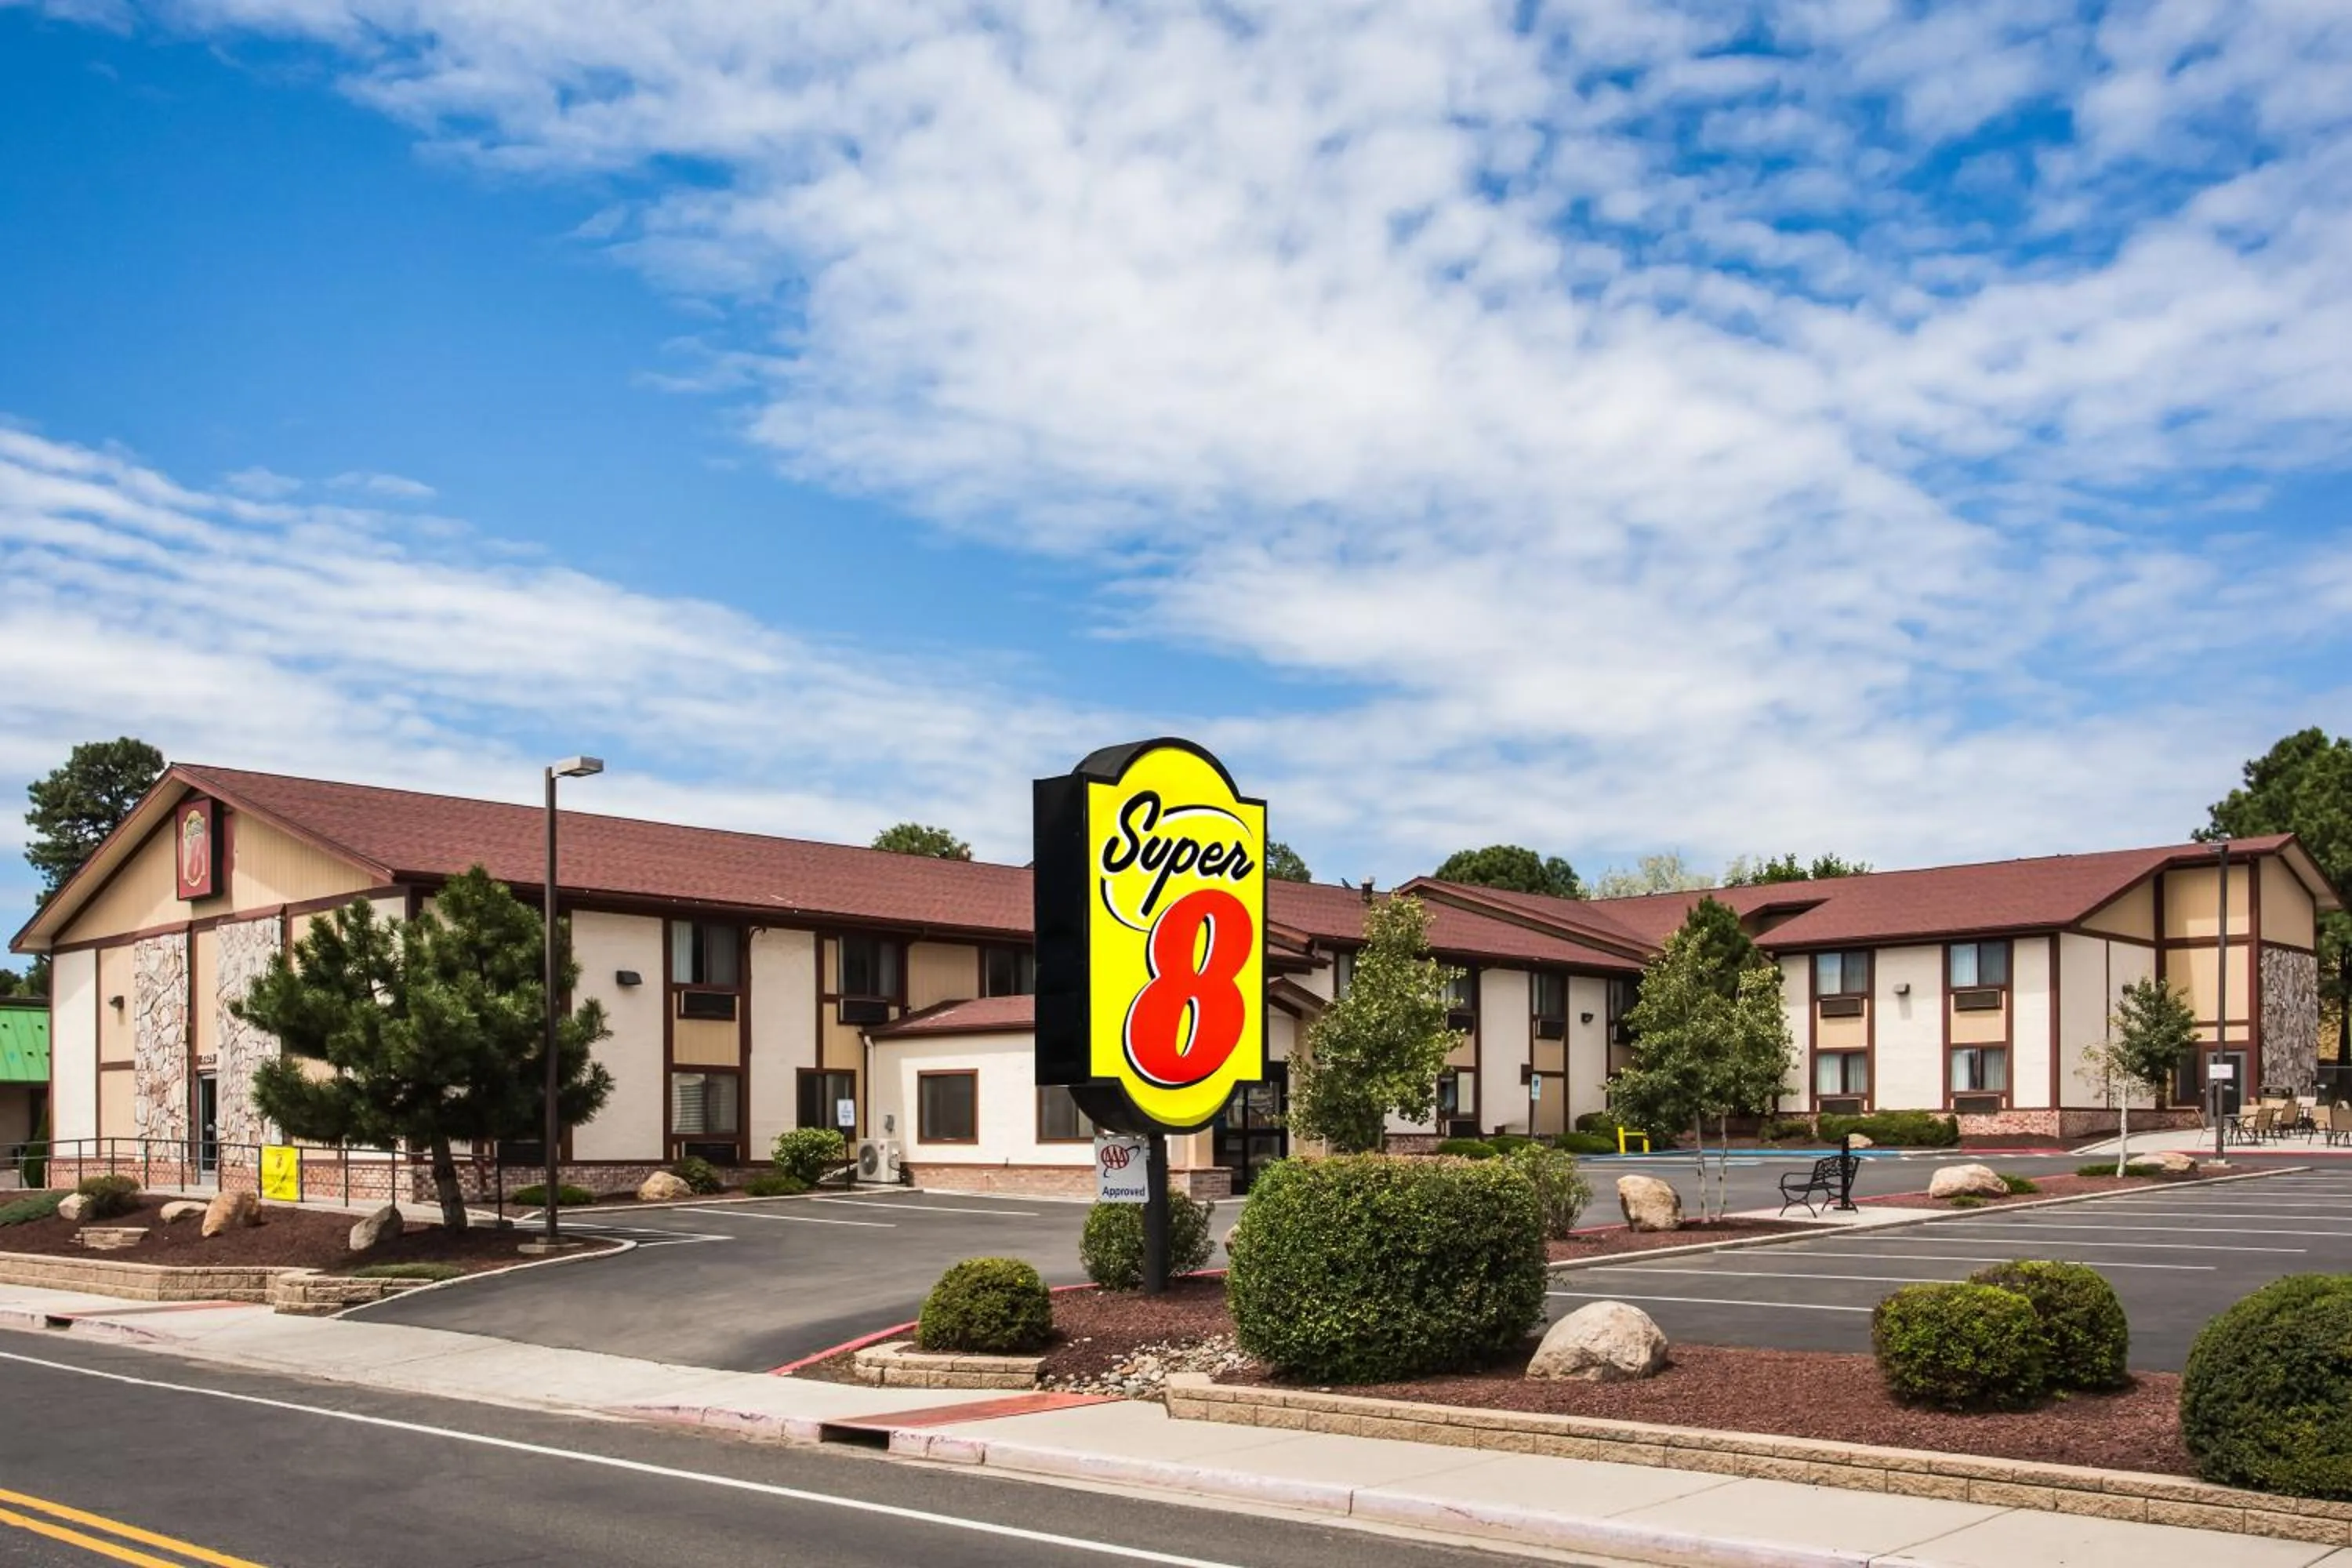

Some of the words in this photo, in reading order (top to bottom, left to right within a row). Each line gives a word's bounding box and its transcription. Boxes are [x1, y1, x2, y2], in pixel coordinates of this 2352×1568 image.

[1102, 790, 1254, 916] Super
[1123, 889, 1253, 1088] 8
[1102, 1145, 1129, 1169] AAA
[1102, 1185, 1145, 1198] Approved
